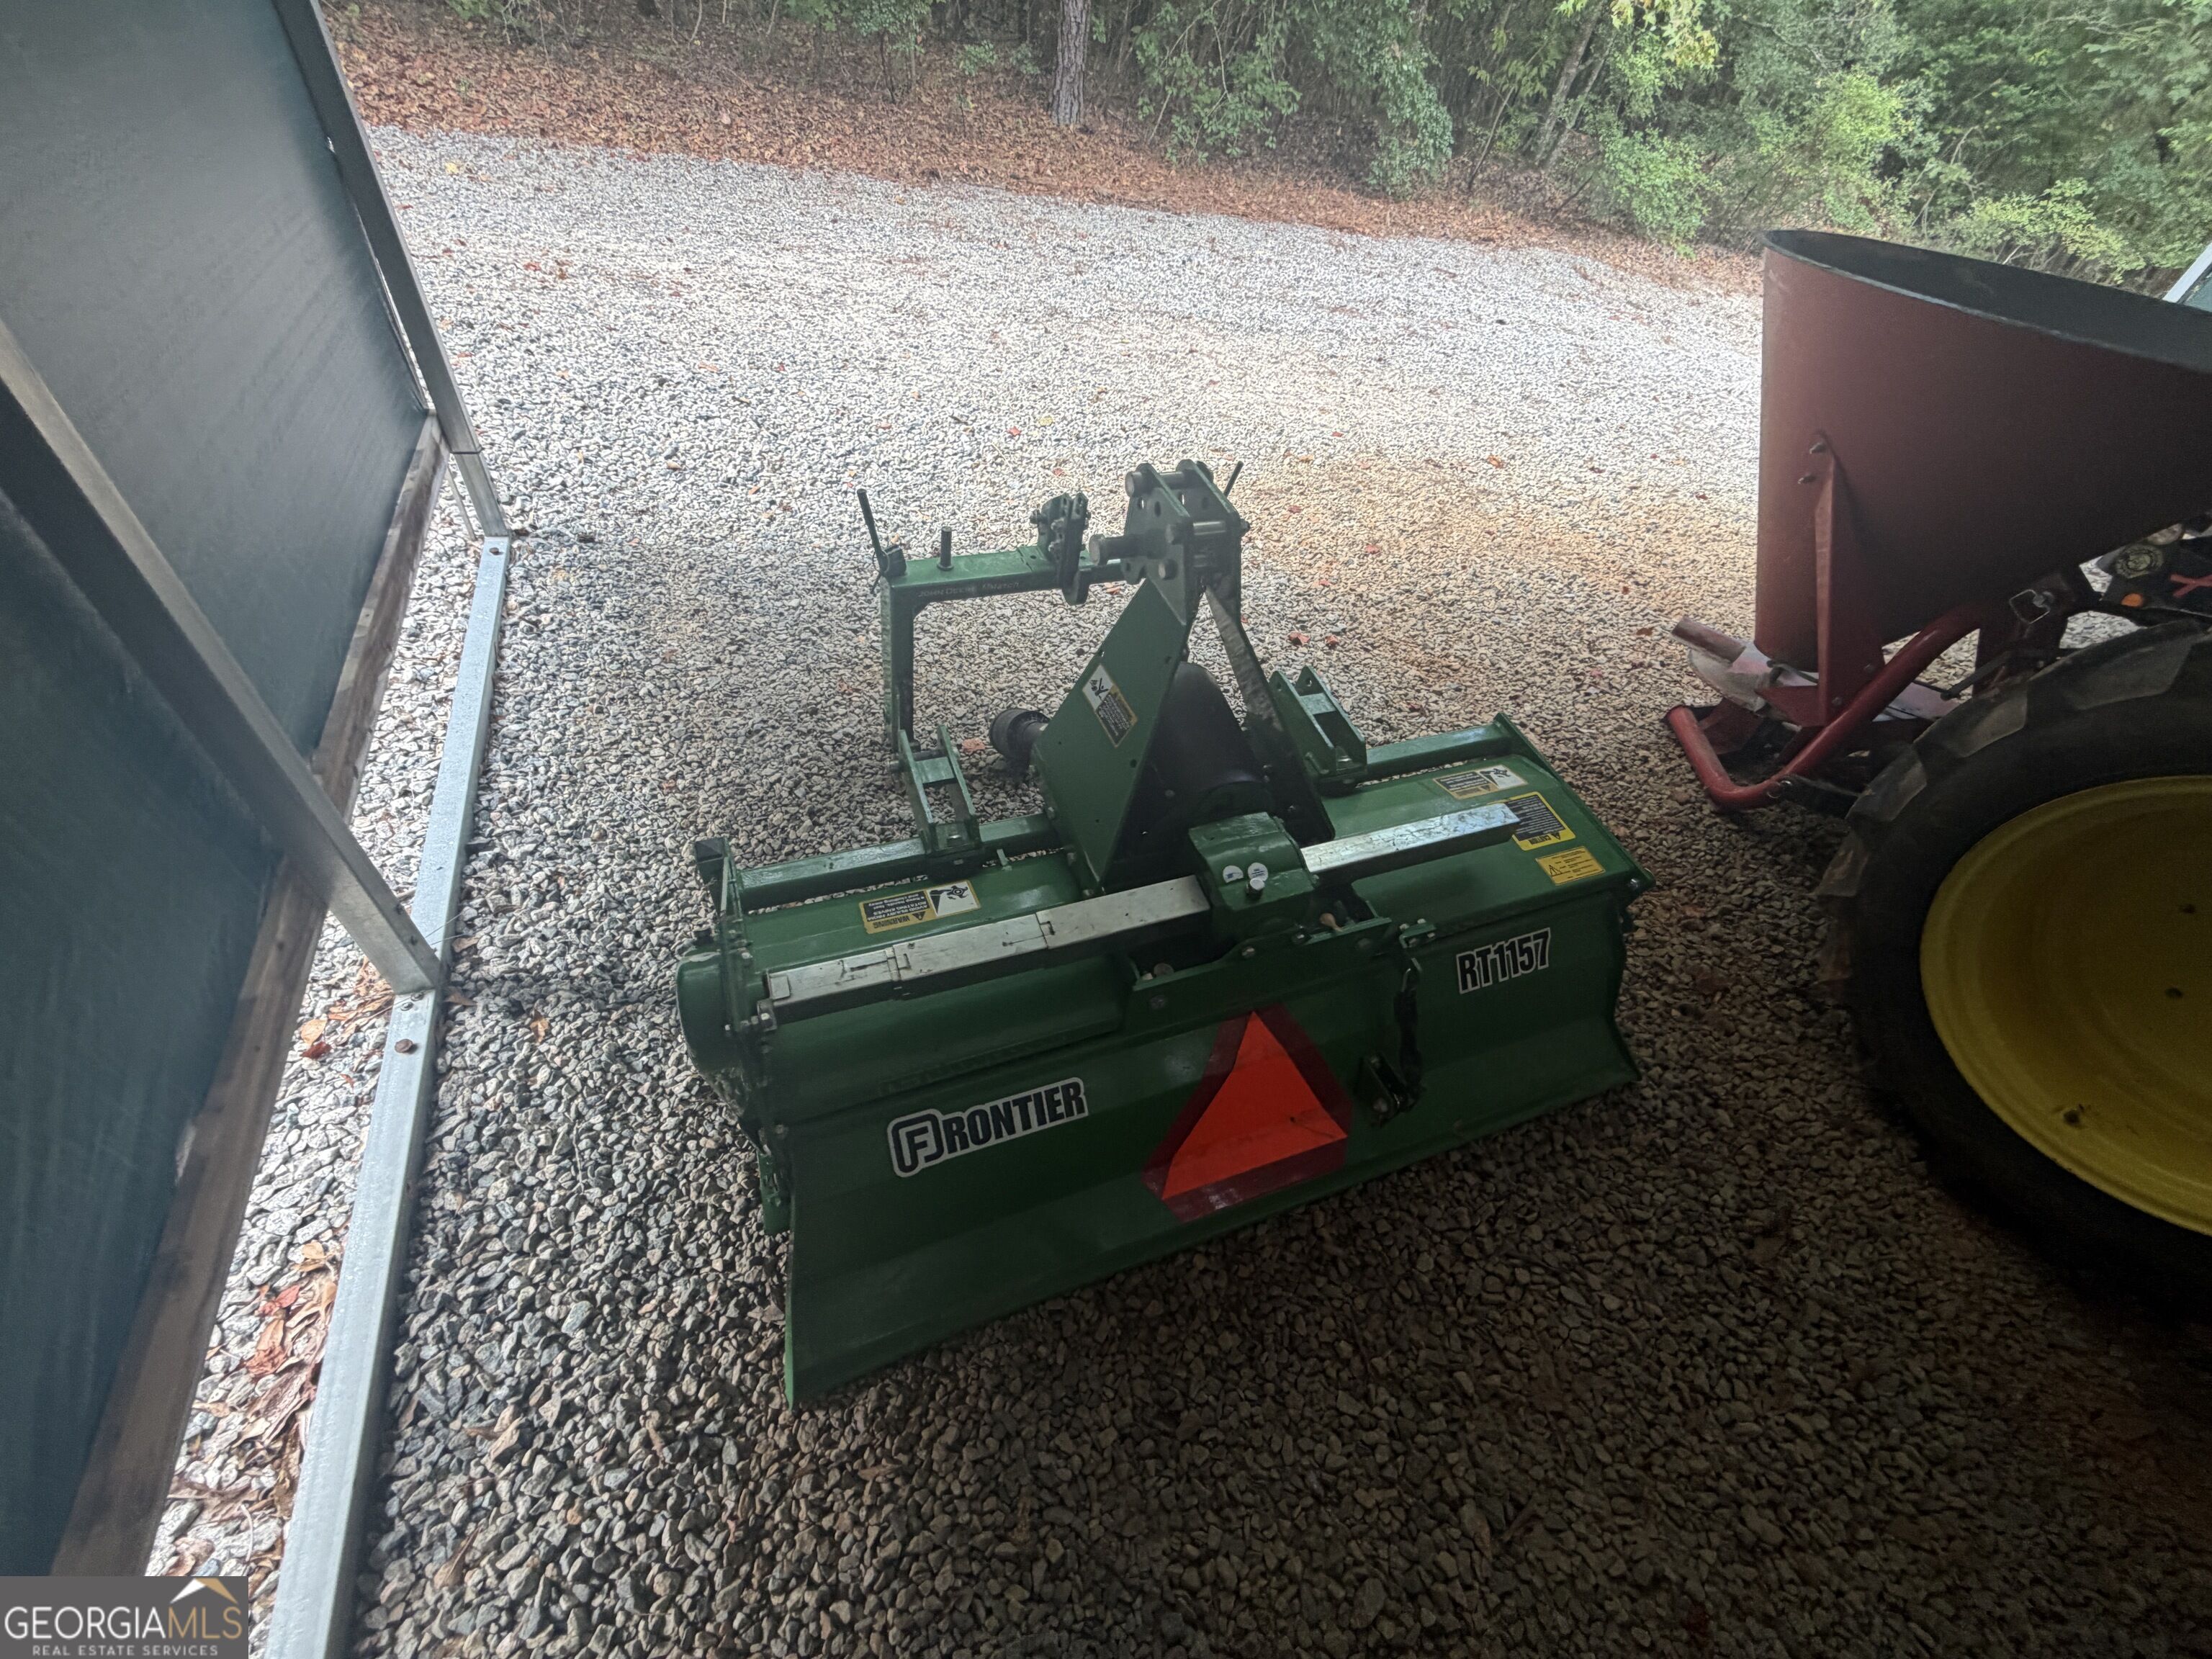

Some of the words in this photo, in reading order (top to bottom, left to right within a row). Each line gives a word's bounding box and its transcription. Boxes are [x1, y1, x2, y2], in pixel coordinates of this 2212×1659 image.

[873, 915, 910, 928] WARNING
[1457, 929, 1551, 992] RT1157
[890, 1080, 1087, 1175] FRONTIER
